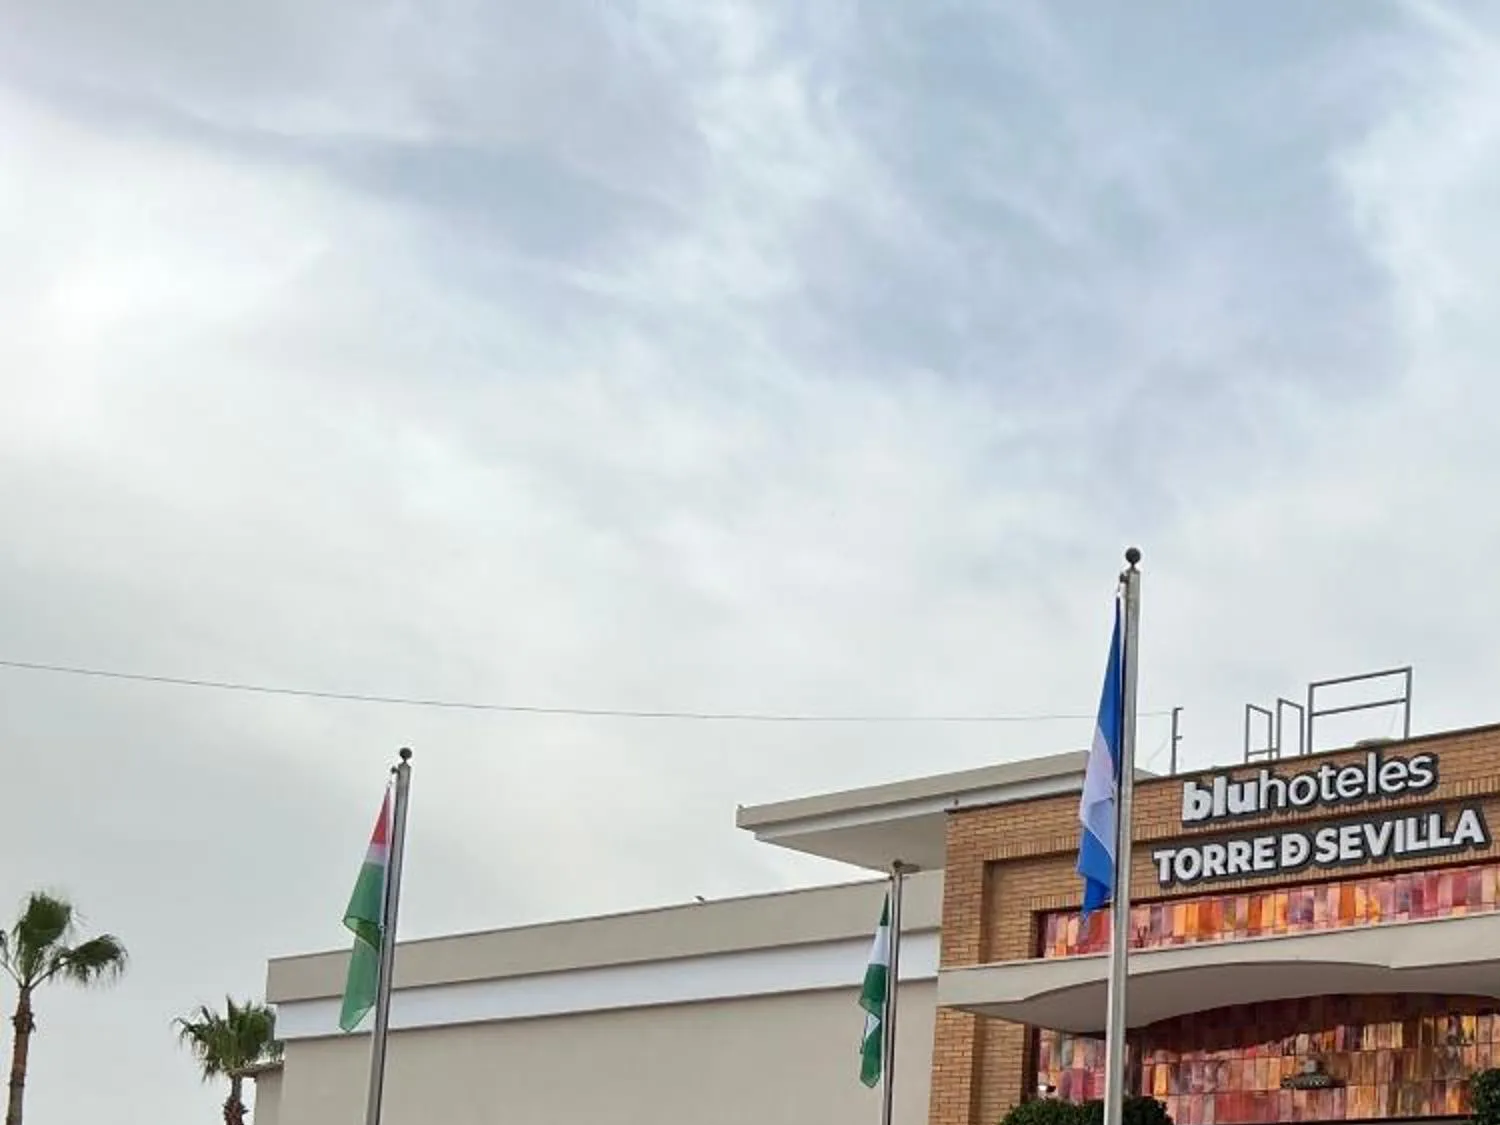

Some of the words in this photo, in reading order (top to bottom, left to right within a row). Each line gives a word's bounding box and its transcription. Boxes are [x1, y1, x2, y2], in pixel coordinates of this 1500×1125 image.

[1183, 753, 1434, 822] bluhoteles
[1154, 836, 1275, 882] TORRE
[1315, 810, 1485, 863] SEVILLA
